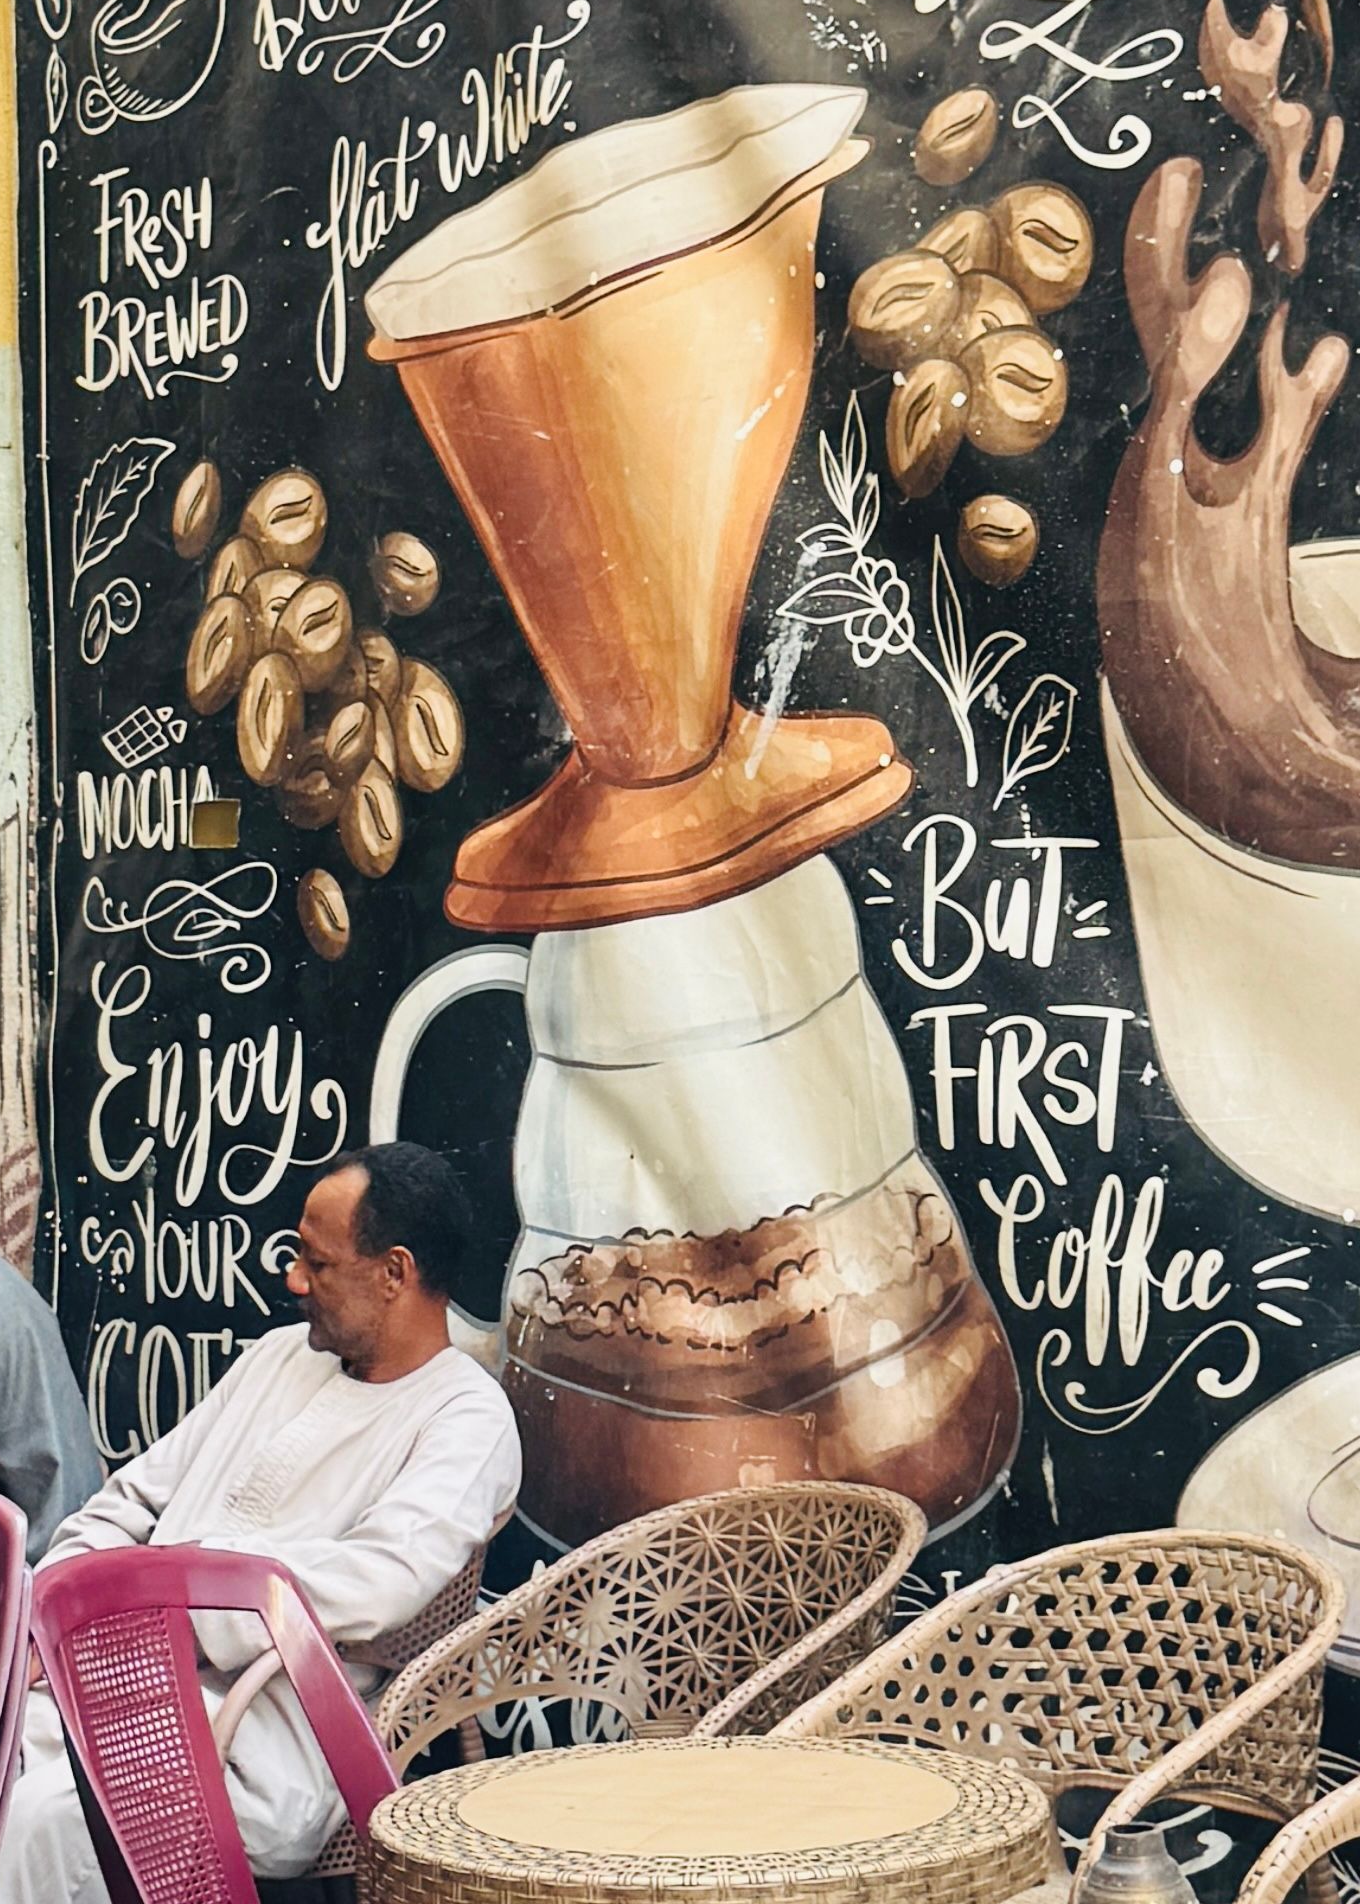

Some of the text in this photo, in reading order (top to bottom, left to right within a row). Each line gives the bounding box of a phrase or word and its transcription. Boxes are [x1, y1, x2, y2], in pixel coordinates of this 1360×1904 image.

[75, 273, 249, 401] BREWED
[88, 960, 348, 1209] Enjoy
[905, 1002, 1136, 1186] FIRST
[131, 1187, 272, 1317] YOUR
[978, 1172, 1232, 1367] Coffee
